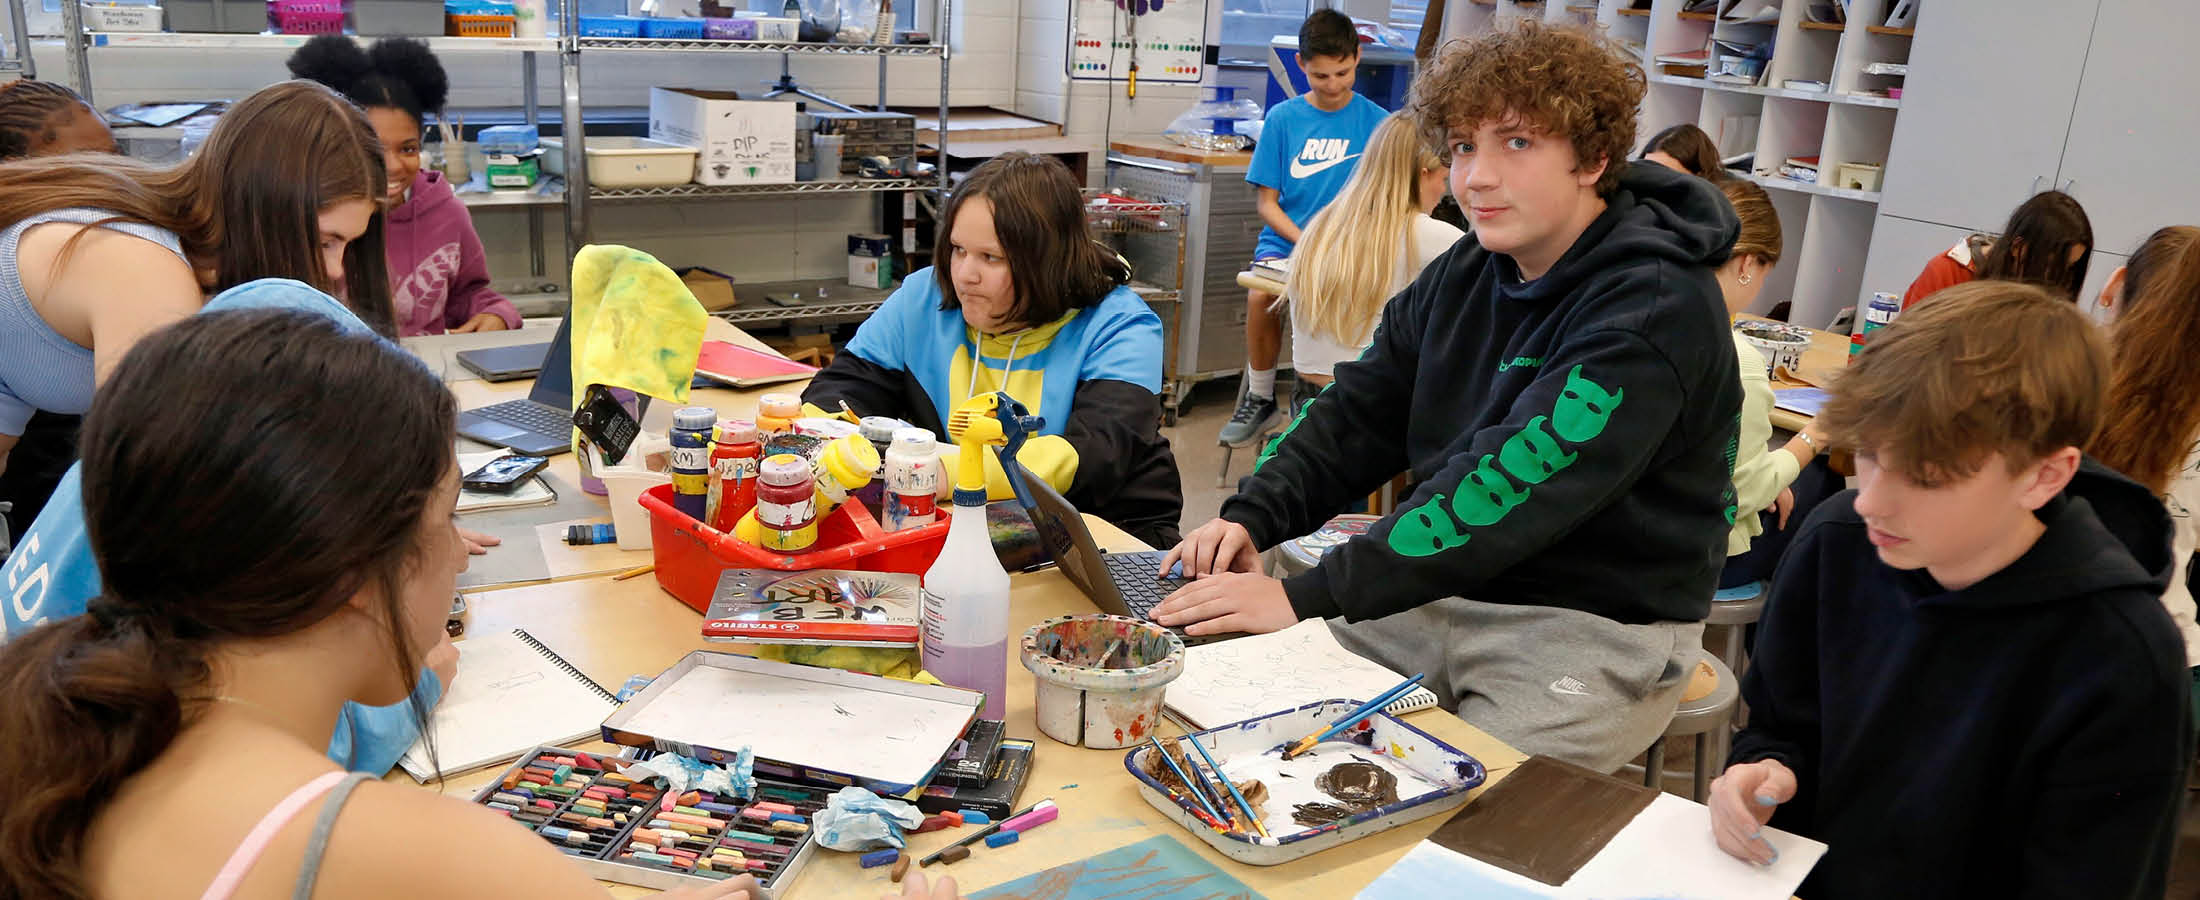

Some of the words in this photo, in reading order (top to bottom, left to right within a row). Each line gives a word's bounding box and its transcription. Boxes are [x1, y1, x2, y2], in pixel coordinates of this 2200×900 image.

[1300, 138, 1351, 161] RUN
[711, 622, 778, 630] STABILO
[1558, 675, 1588, 692] NIKE
[957, 759, 980, 769] 24
